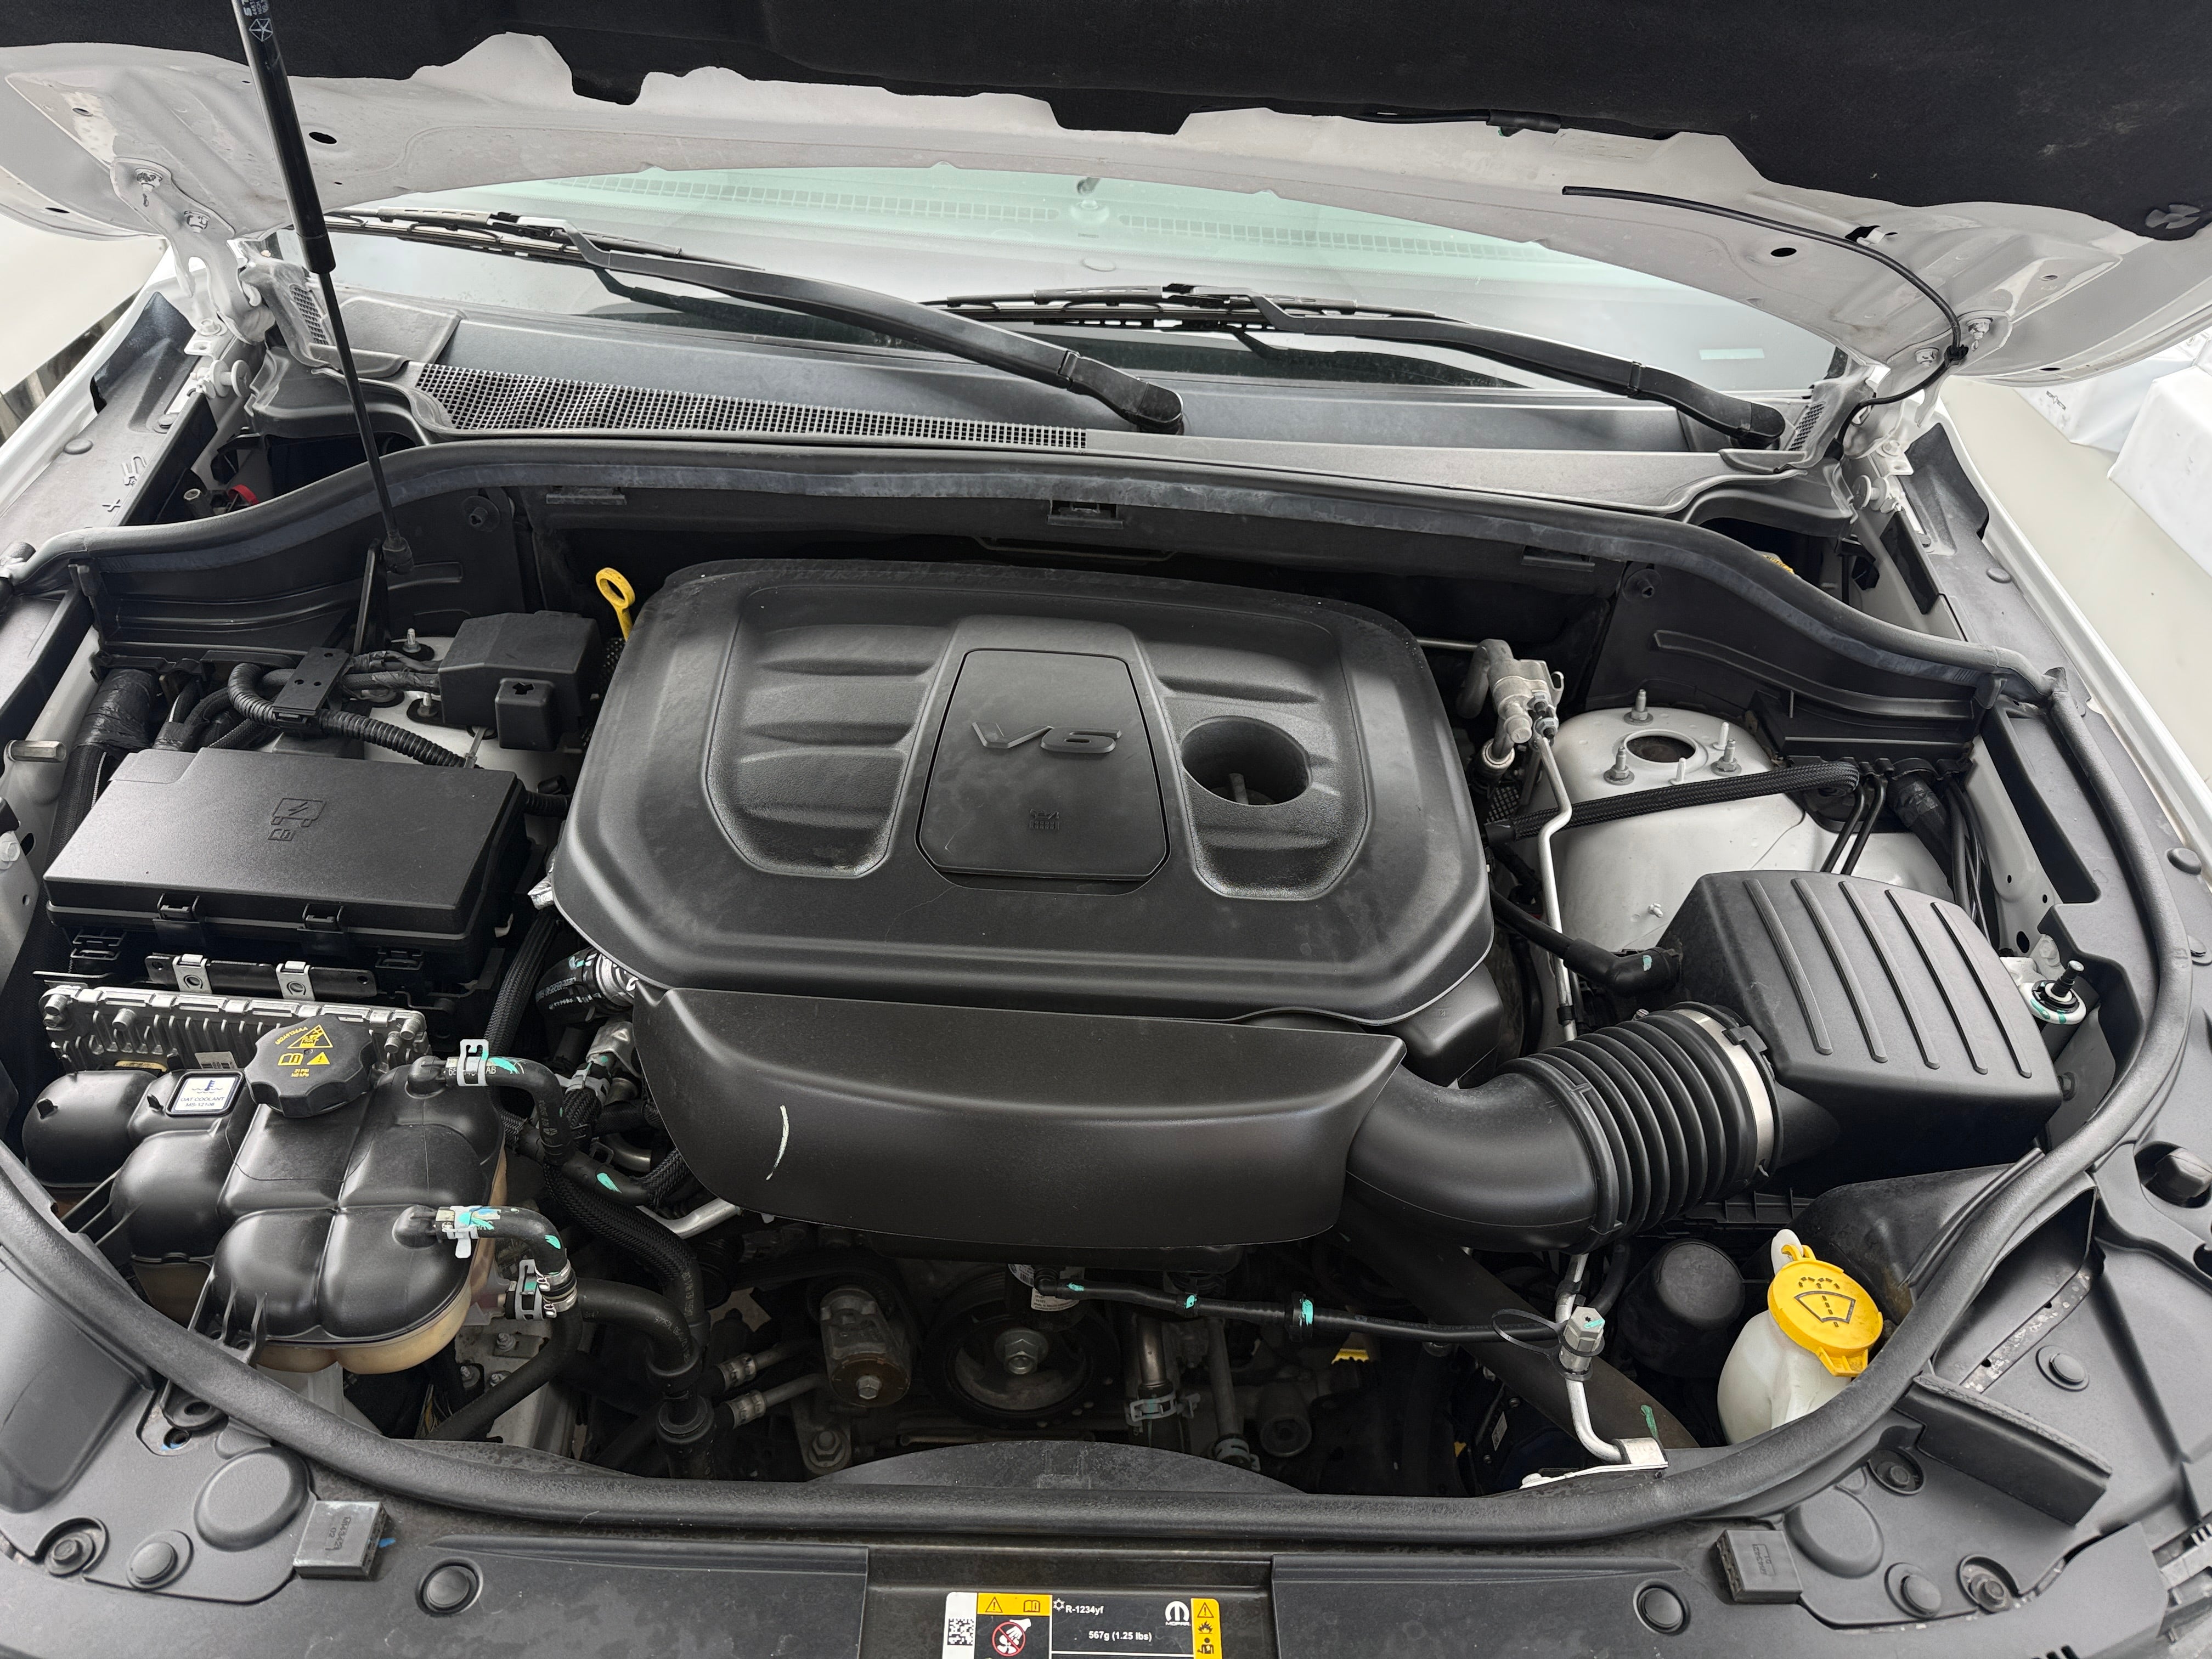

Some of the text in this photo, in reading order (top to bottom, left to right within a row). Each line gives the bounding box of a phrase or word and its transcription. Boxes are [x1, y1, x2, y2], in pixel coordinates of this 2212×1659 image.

[971, 721, 1122, 754] V6
[1065, 1605, 1104, 1615] R-1234yf
[1088, 1631, 1152, 1642] 567g (1.25 lbs)
